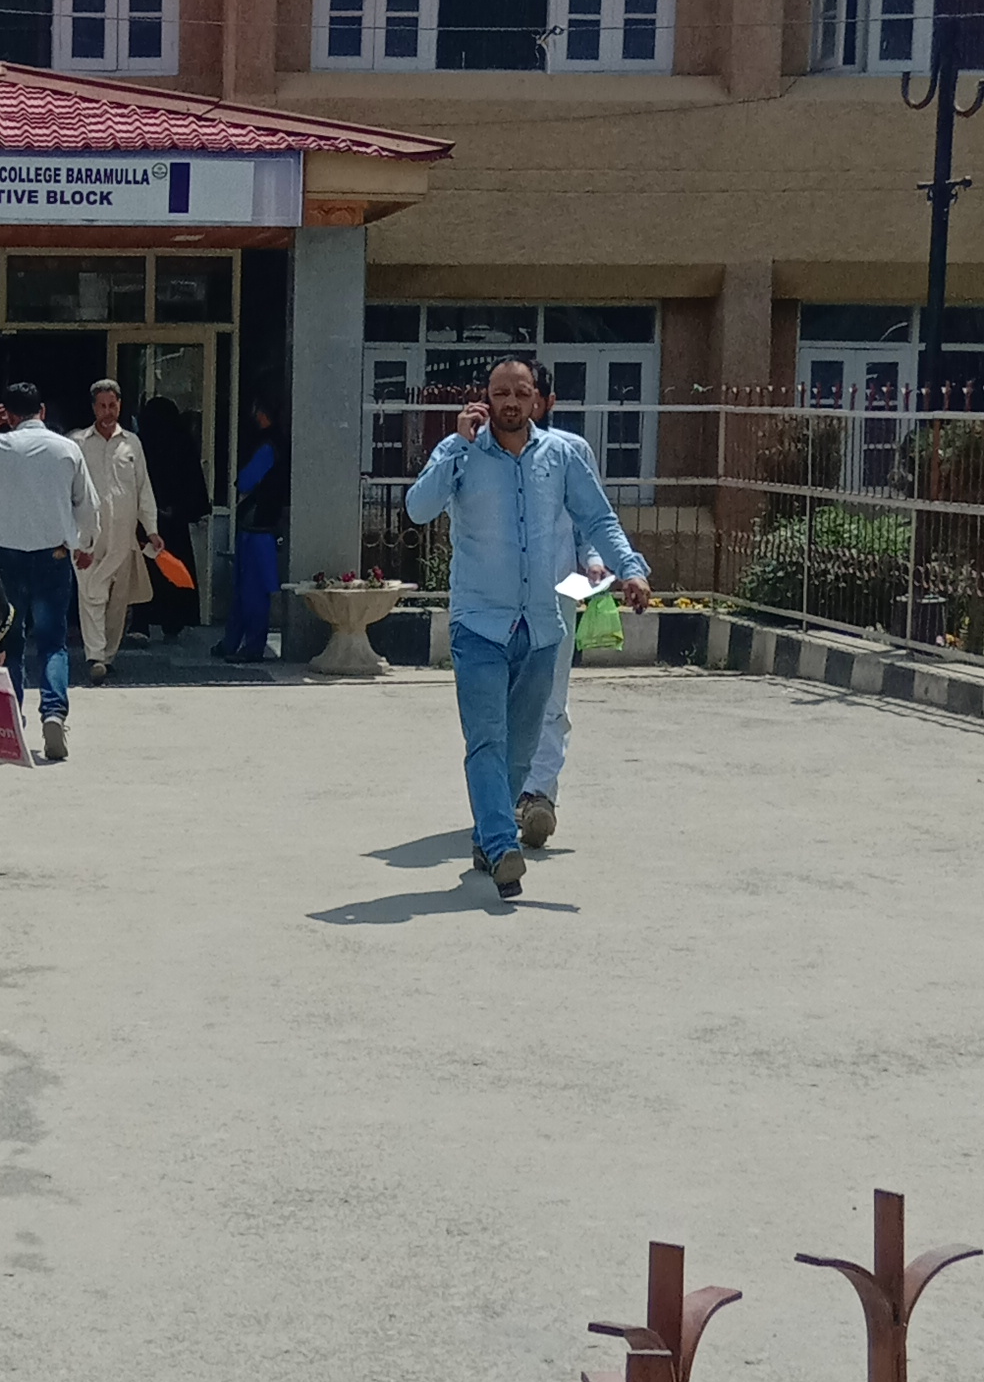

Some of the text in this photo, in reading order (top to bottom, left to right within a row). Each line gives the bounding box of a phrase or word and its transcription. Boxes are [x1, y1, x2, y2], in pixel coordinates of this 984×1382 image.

[0, 166, 61, 184] COLLEGE
[66, 168, 150, 185] BARAMULLA
[46, 190, 113, 206] BLOCK
